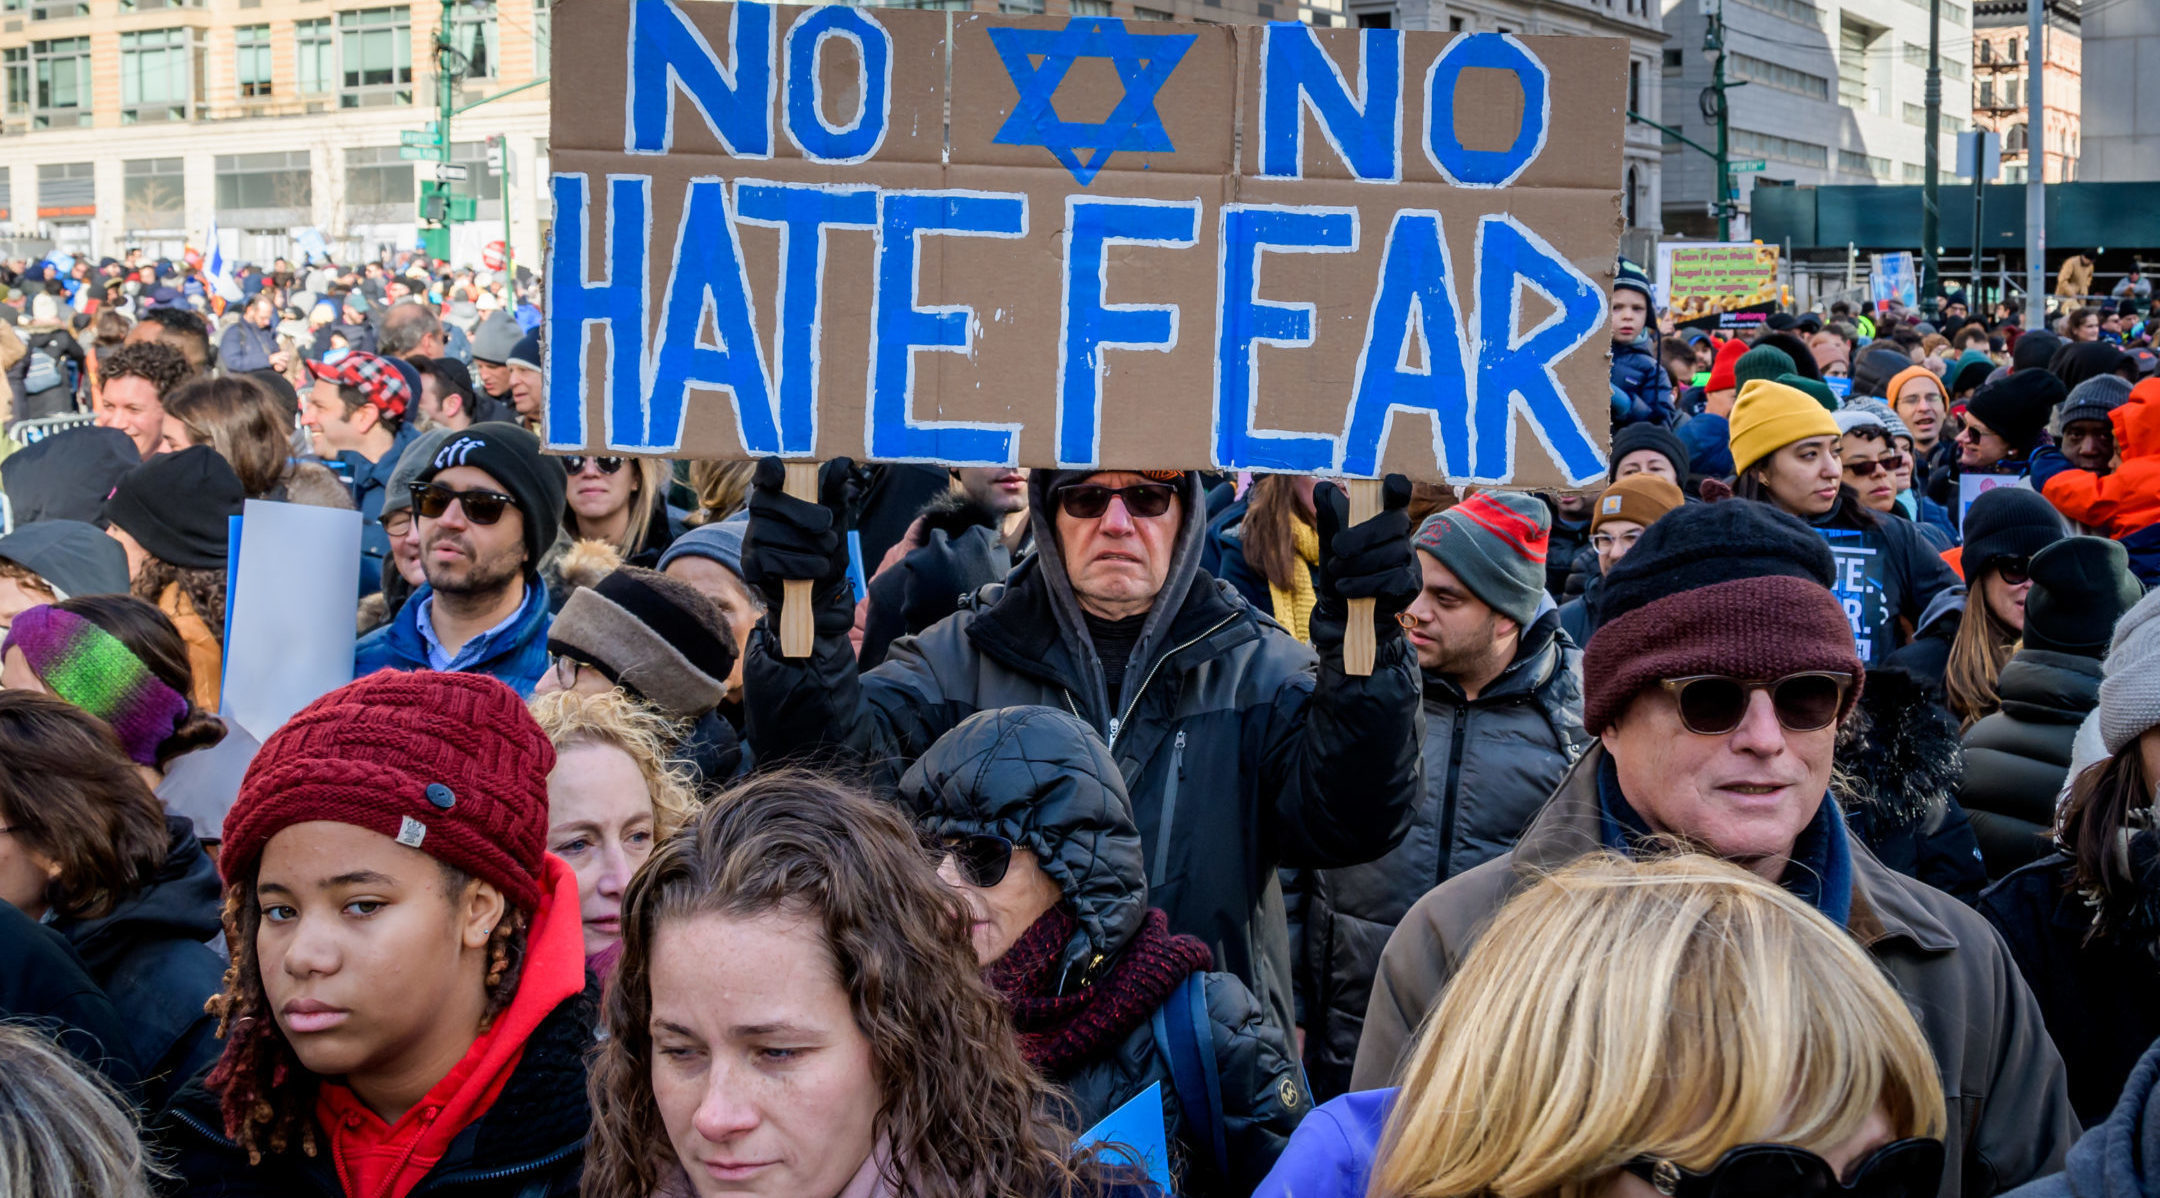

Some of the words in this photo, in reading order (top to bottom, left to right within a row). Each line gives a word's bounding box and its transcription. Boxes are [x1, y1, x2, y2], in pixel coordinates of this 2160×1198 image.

[624, 0, 894, 165] NO
[1257, 20, 1551, 190] NO
[1675, 252, 1699, 261] Even
[1710, 254, 1727, 263] you
[1729, 251, 1753, 260] think
[1691, 285, 1712, 294] your
[545, 172, 1029, 468] HATE
[1055, 195, 1610, 488] FEAR
[1832, 556, 1874, 594] TE.
